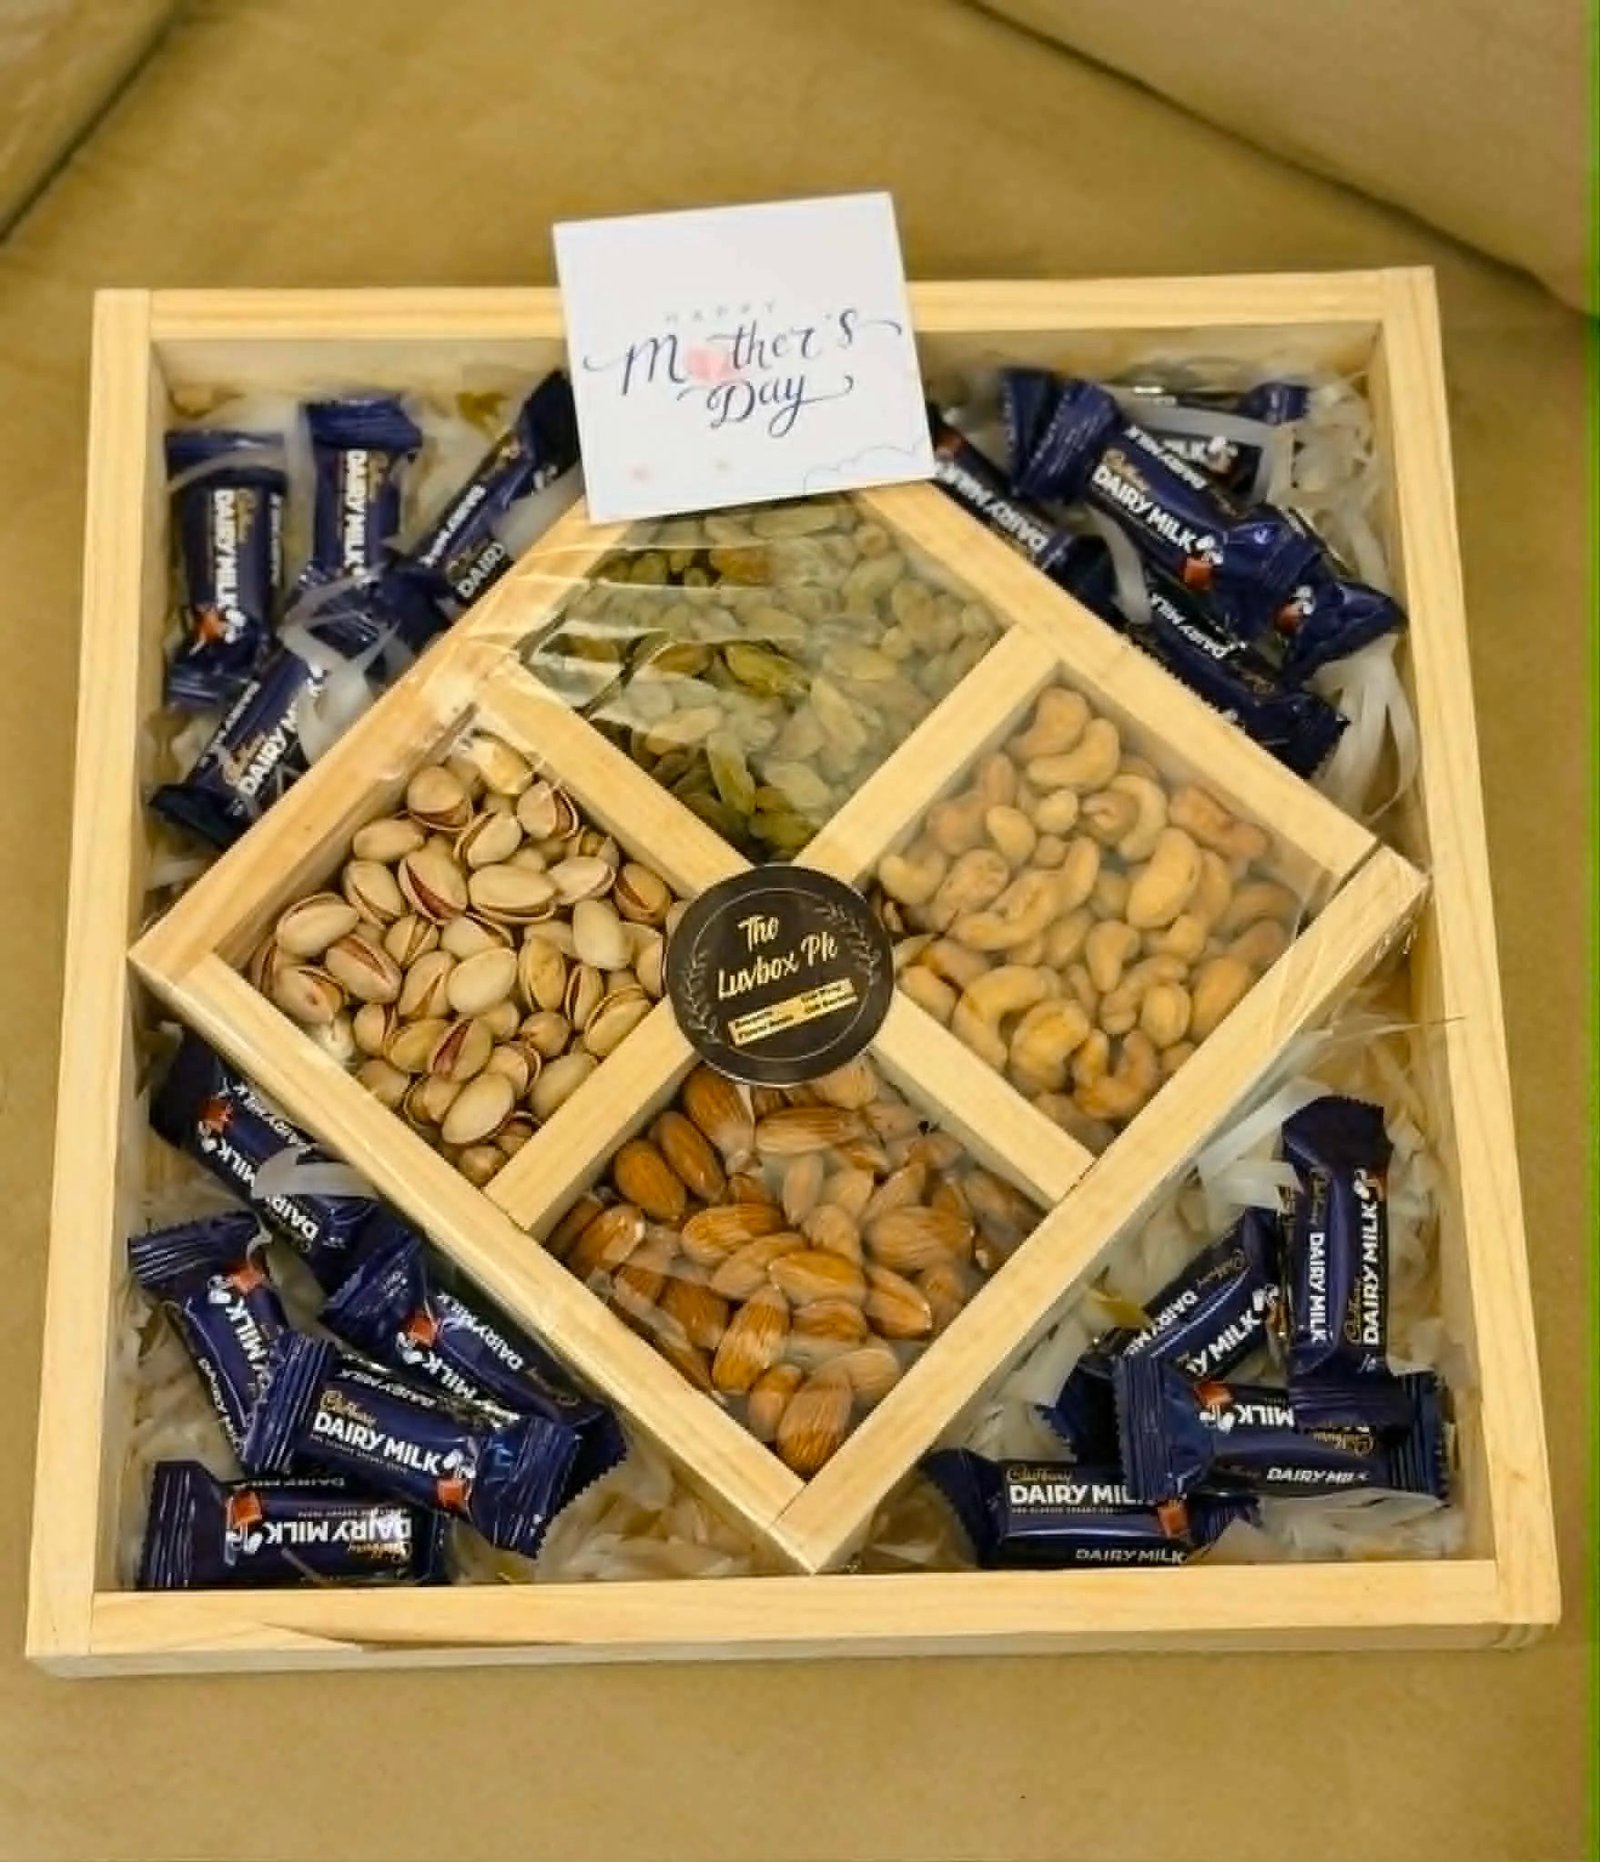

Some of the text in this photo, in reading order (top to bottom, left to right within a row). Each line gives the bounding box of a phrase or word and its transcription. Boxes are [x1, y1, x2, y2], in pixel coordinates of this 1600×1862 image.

[676, 373, 854, 438] Day
[980, 501, 1049, 553] DAIRY
[1092, 465, 1154, 513] DAIRY
[1147, 506, 1197, 553] MILK
[237, 726, 287, 795] DAIRY
[737, 914, 780, 951] The
[718, 952, 800, 1001] Luvbox
[266, 1195, 319, 1241] DAIR
[1361, 1200, 1379, 1262] MILK
[1309, 1232, 1326, 1293] DAIRY
[225, 1297, 268, 1361] MILK
[1150, 1290, 1199, 1336] DAIRY
[1309, 1295, 1327, 1344] MILK
[1362, 1264, 1379, 1345] DAIRY
[473, 1324, 524, 1370] DAIRY
[1208, 1309, 1261, 1361] MILK
[422, 1352, 478, 1399] MILK
[1234, 1404, 1295, 1427] MILK
[313, 1411, 387, 1450] DAIRY
[383, 1437, 442, 1476] MILK
[1009, 1485, 1088, 1505] DAIRY
[1267, 1467, 1327, 1483] DAIRY
[263, 1518, 412, 1544] DAIRY MILK
[1075, 1548, 1188, 1564] DAIRY MILK
